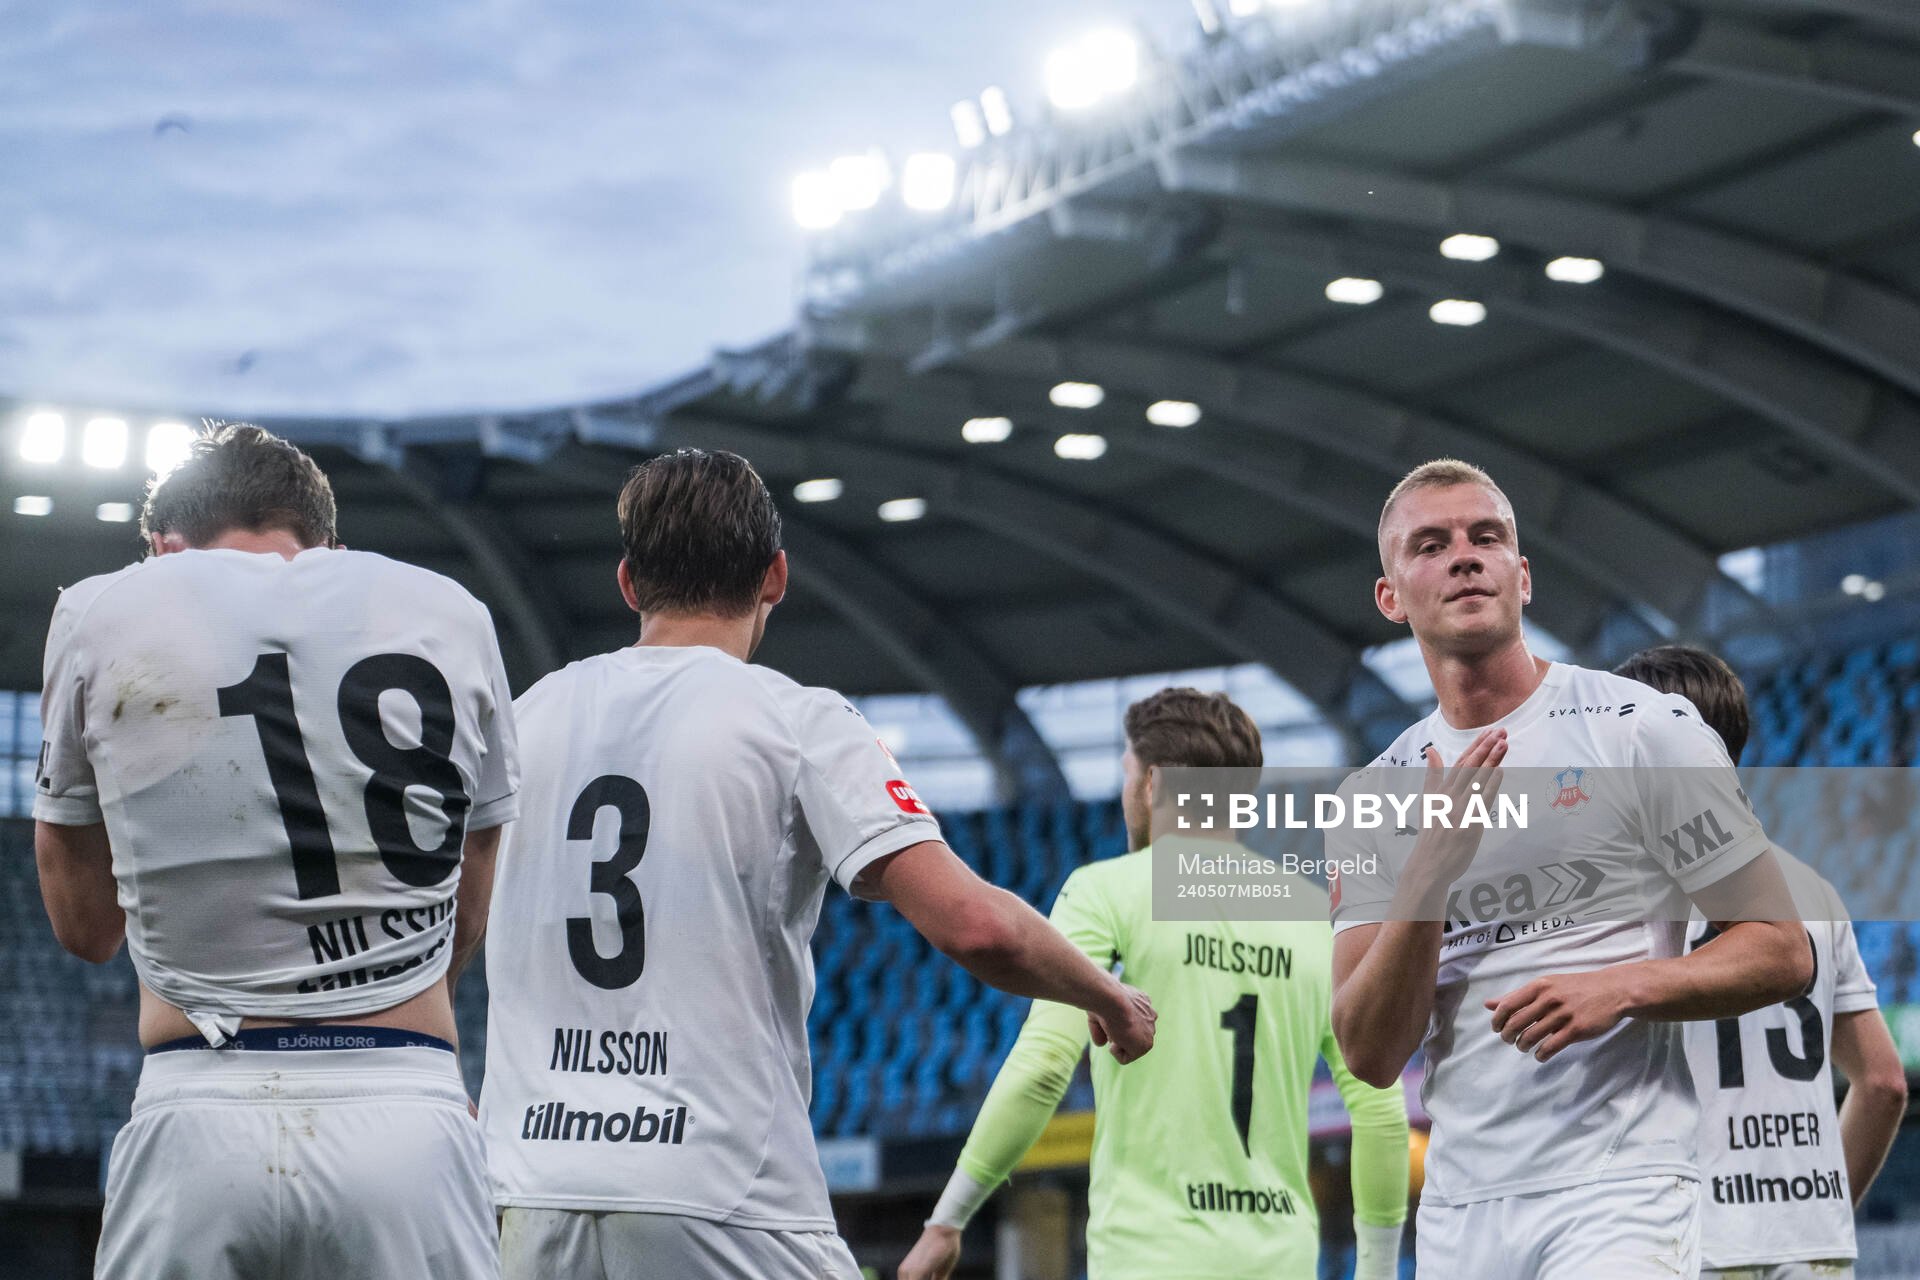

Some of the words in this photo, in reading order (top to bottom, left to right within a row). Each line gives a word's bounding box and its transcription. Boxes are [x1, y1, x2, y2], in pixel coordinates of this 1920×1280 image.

[1548, 706, 1612, 718] SVANER
[217, 652, 472, 900] 18
[1560, 788, 1579, 801] HIF
[1660, 808, 1735, 871] XXL
[566, 774, 651, 990] 3
[1521, 913, 1576, 936] ELEDA
[277, 1034, 331, 1049] BJÖRN
[333, 1035, 377, 1048] BORG
[550, 1027, 668, 1076] NILSSON
[1220, 993, 1259, 1159] 1
[521, 1102, 688, 1145] tillmobil
[1728, 1112, 1820, 1151] LOEPER
[1711, 1169, 1844, 1205] tillmobil
